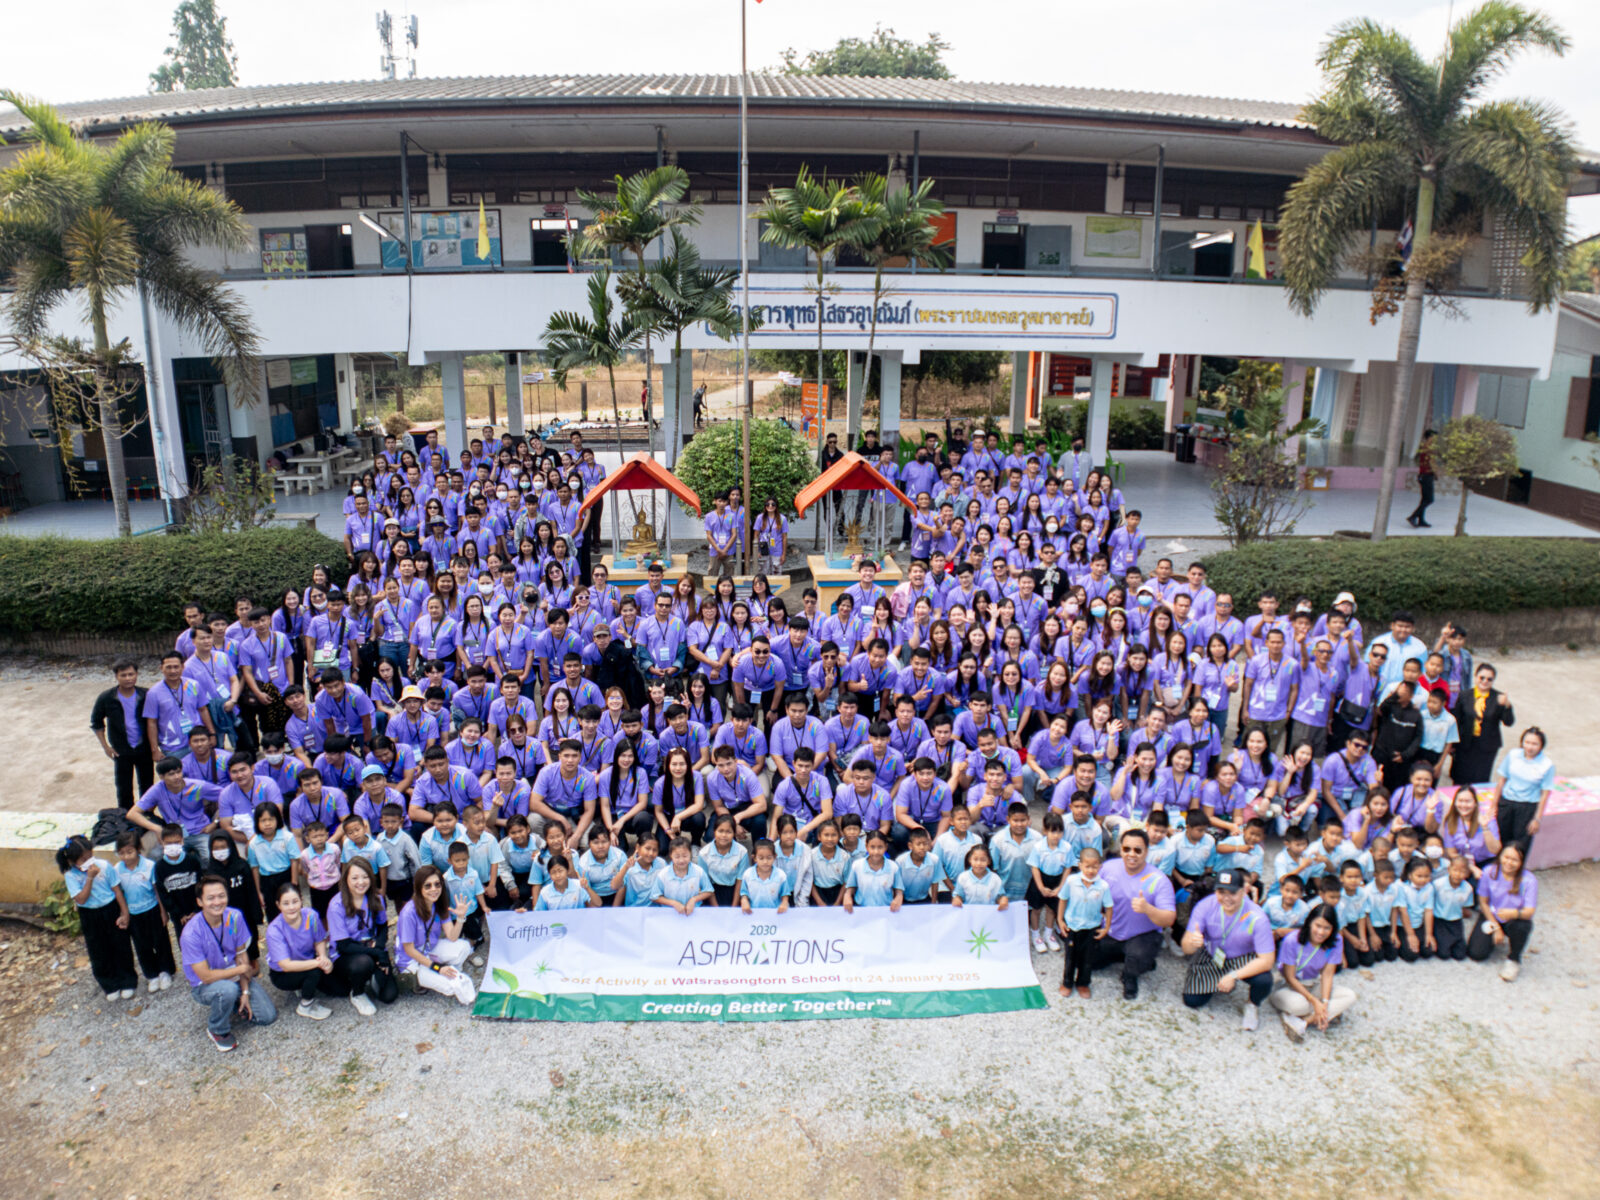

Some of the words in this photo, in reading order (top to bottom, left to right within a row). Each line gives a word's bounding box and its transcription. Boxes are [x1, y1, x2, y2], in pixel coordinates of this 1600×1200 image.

[732, 296, 912, 330] คารพุทธโสธรอุปถัมภ์
[506, 924, 549, 942] Griffith
[749, 925, 777, 936] 2030
[678, 939, 845, 966] ASPIRATIONS
[595, 976, 649, 987] Activity
[654, 977, 667, 986] at
[672, 976, 787, 987] Watsrasongtorn
[791, 974, 841, 984] School
[867, 974, 883, 983] 24
[887, 974, 944, 983] January
[947, 972, 980, 982] 2025
[641, 1001, 723, 1017] Creating
[728, 1001, 787, 1014] Better
